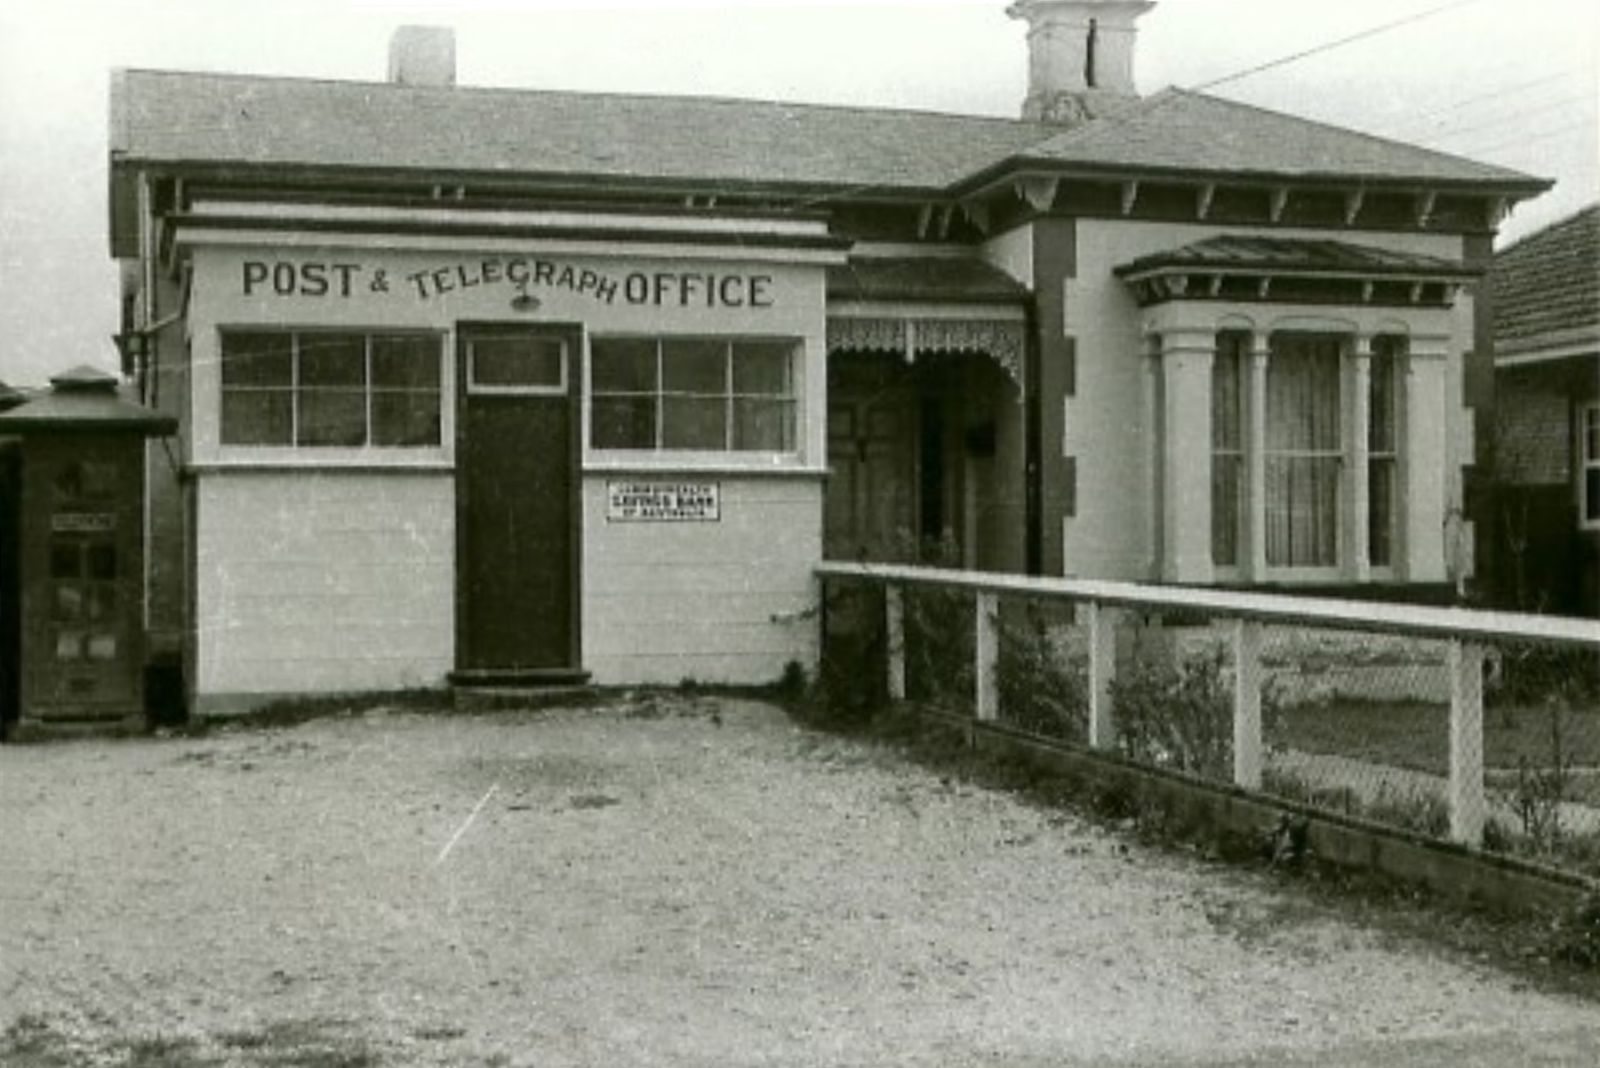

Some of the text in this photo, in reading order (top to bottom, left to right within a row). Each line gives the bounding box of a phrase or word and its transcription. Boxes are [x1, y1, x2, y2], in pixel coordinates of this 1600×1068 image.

[243, 259, 775, 308] POST & TELEGRAPH OFFICE
